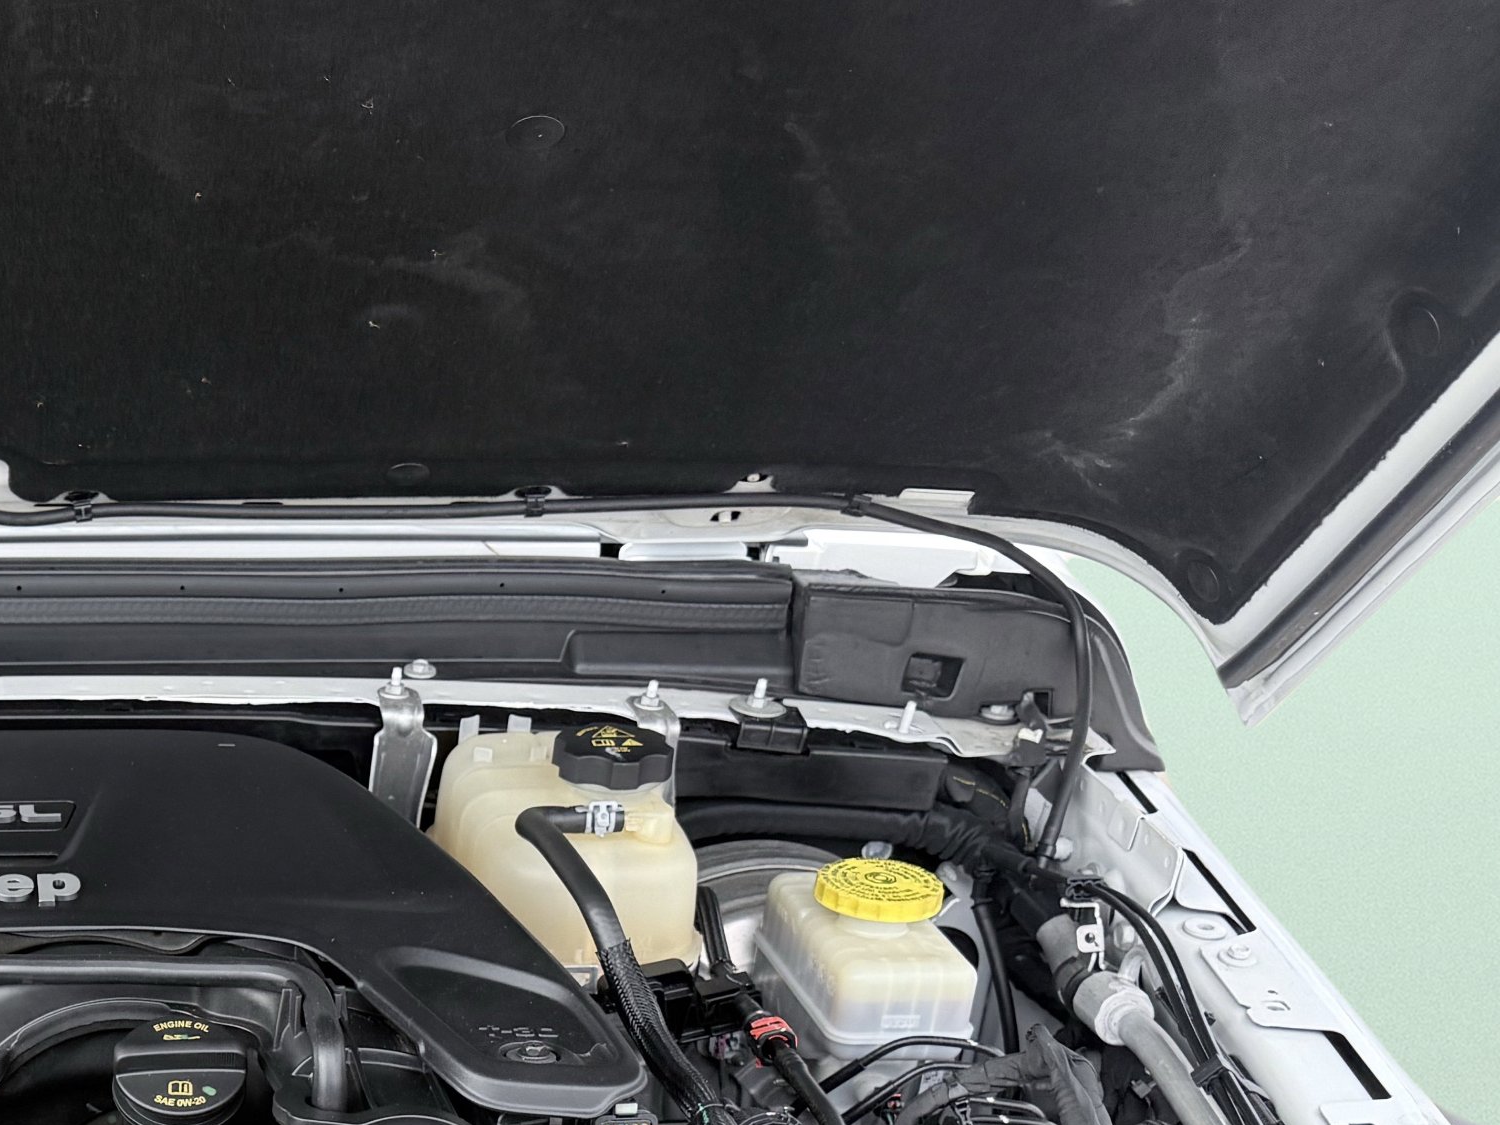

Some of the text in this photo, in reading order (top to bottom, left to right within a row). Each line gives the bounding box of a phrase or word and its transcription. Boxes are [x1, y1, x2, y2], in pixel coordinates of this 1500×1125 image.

[153, 1020, 210, 1033] ENGINE OIL
[154, 1094, 207, 1107] SAE 0W-20
